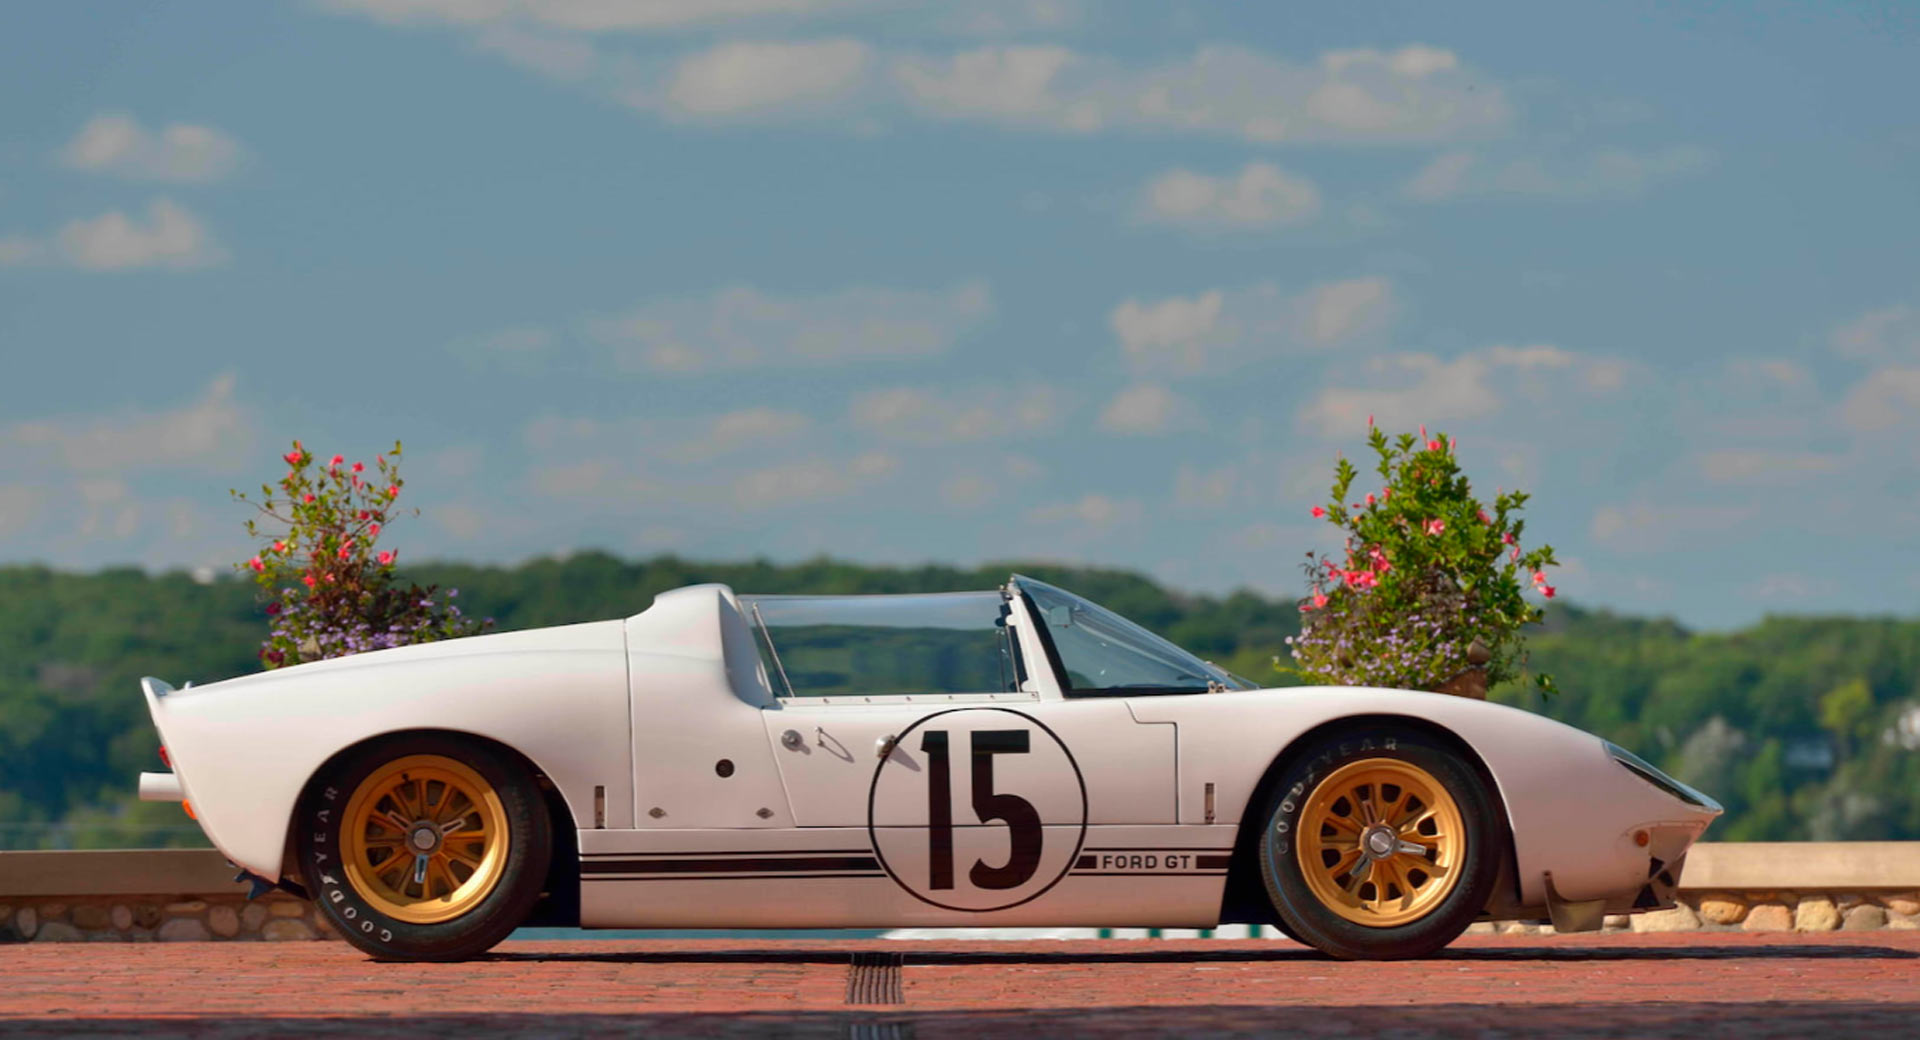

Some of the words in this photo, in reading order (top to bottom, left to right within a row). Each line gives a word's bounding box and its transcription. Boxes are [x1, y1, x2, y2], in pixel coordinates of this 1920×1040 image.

[312, 786, 393, 943] GOODYEAR
[920, 729, 1043, 890] 15
[1102, 855, 1158, 869] FORD
[1164, 855, 1191, 869] GT
